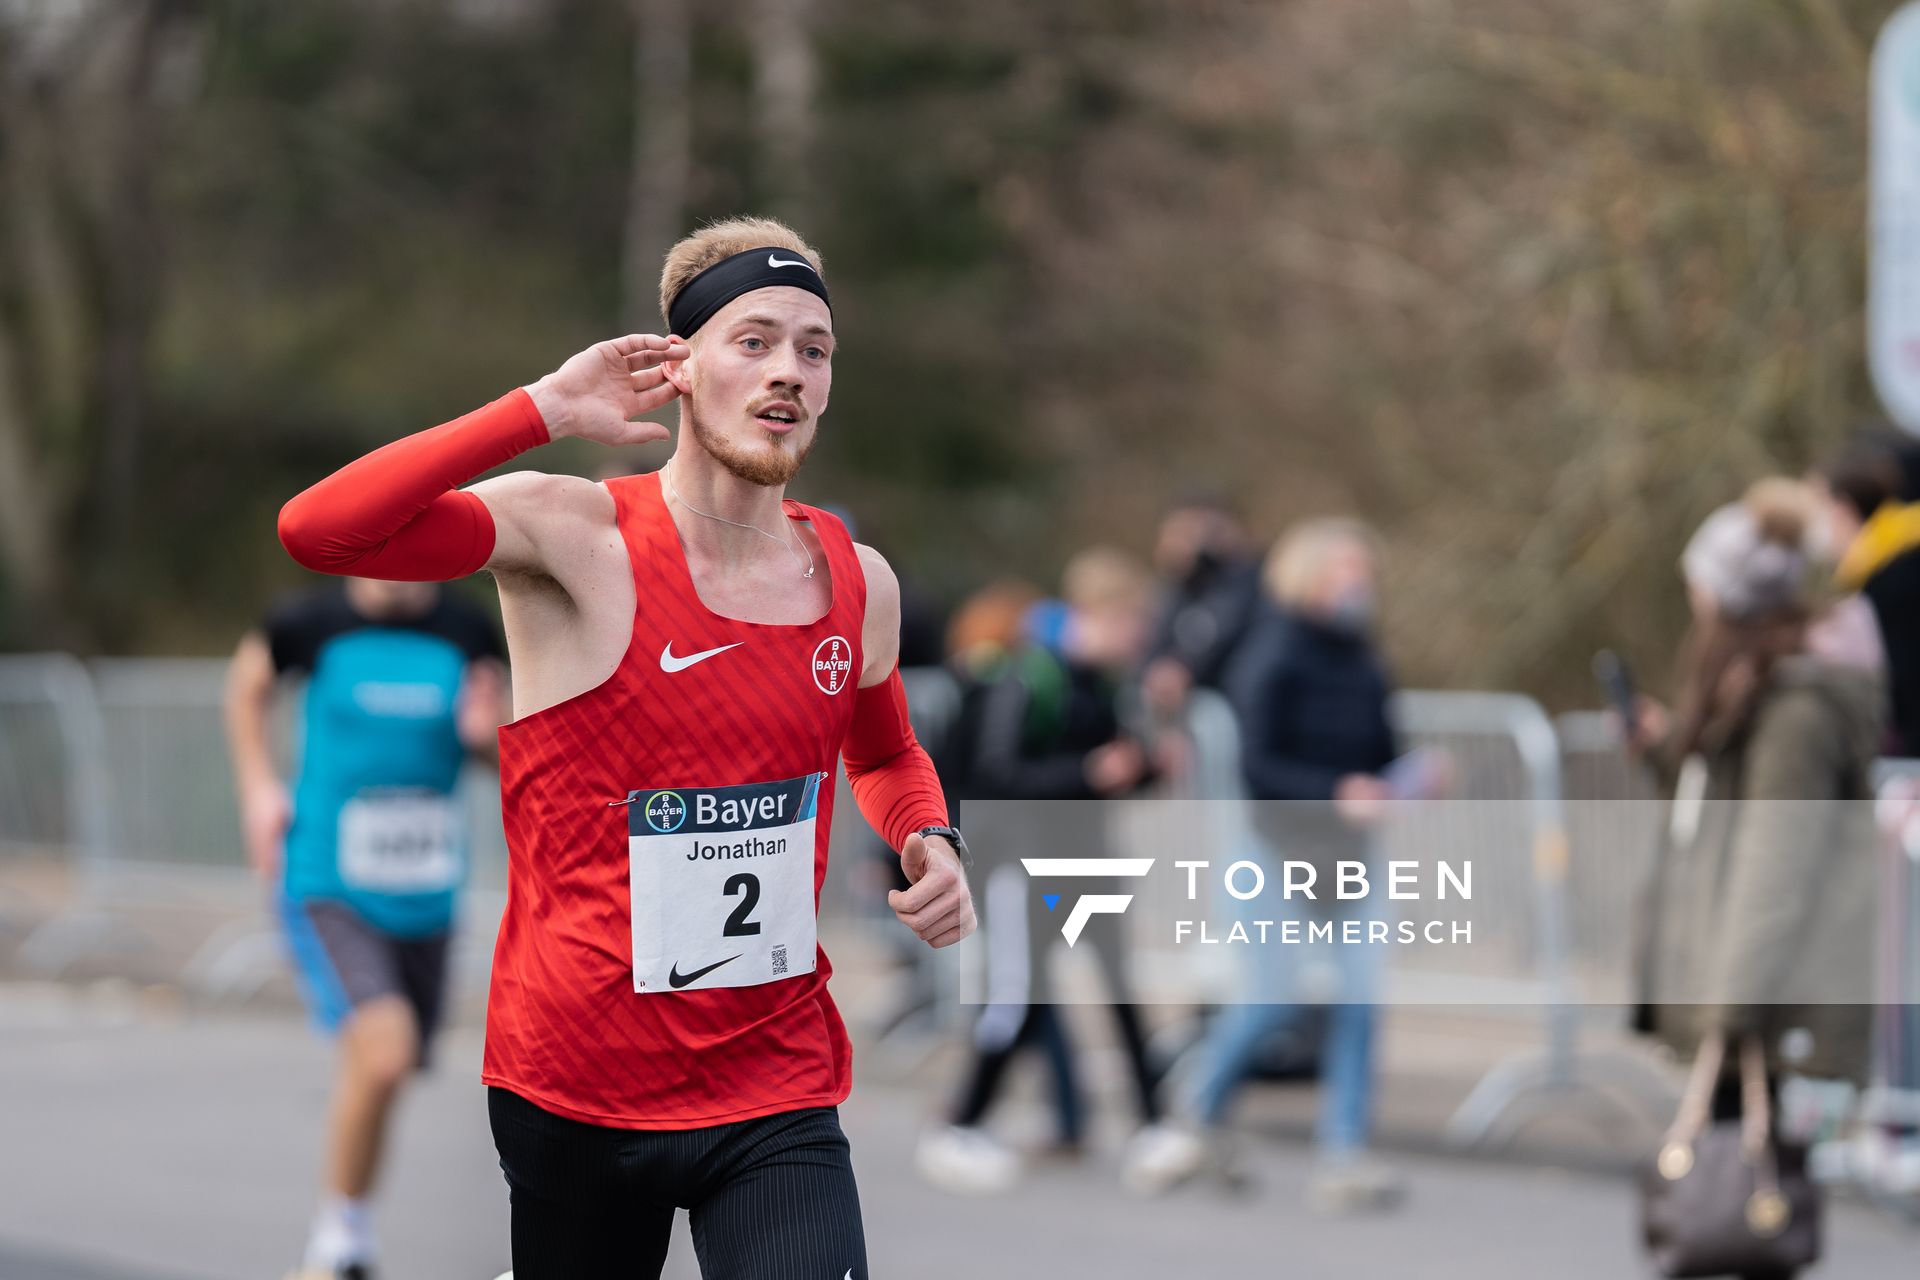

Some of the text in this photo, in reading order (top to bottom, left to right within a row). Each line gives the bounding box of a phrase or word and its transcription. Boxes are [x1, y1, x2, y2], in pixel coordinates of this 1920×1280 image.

[816, 660, 849, 671] BAYER
[829, 641, 840, 691] BAYER
[649, 807, 683, 816] BAYER
[661, 794, 671, 829] BAYER
[696, 793, 788, 829] Bayer
[686, 837, 787, 861] Jonathan
[722, 872, 761, 937] 2
